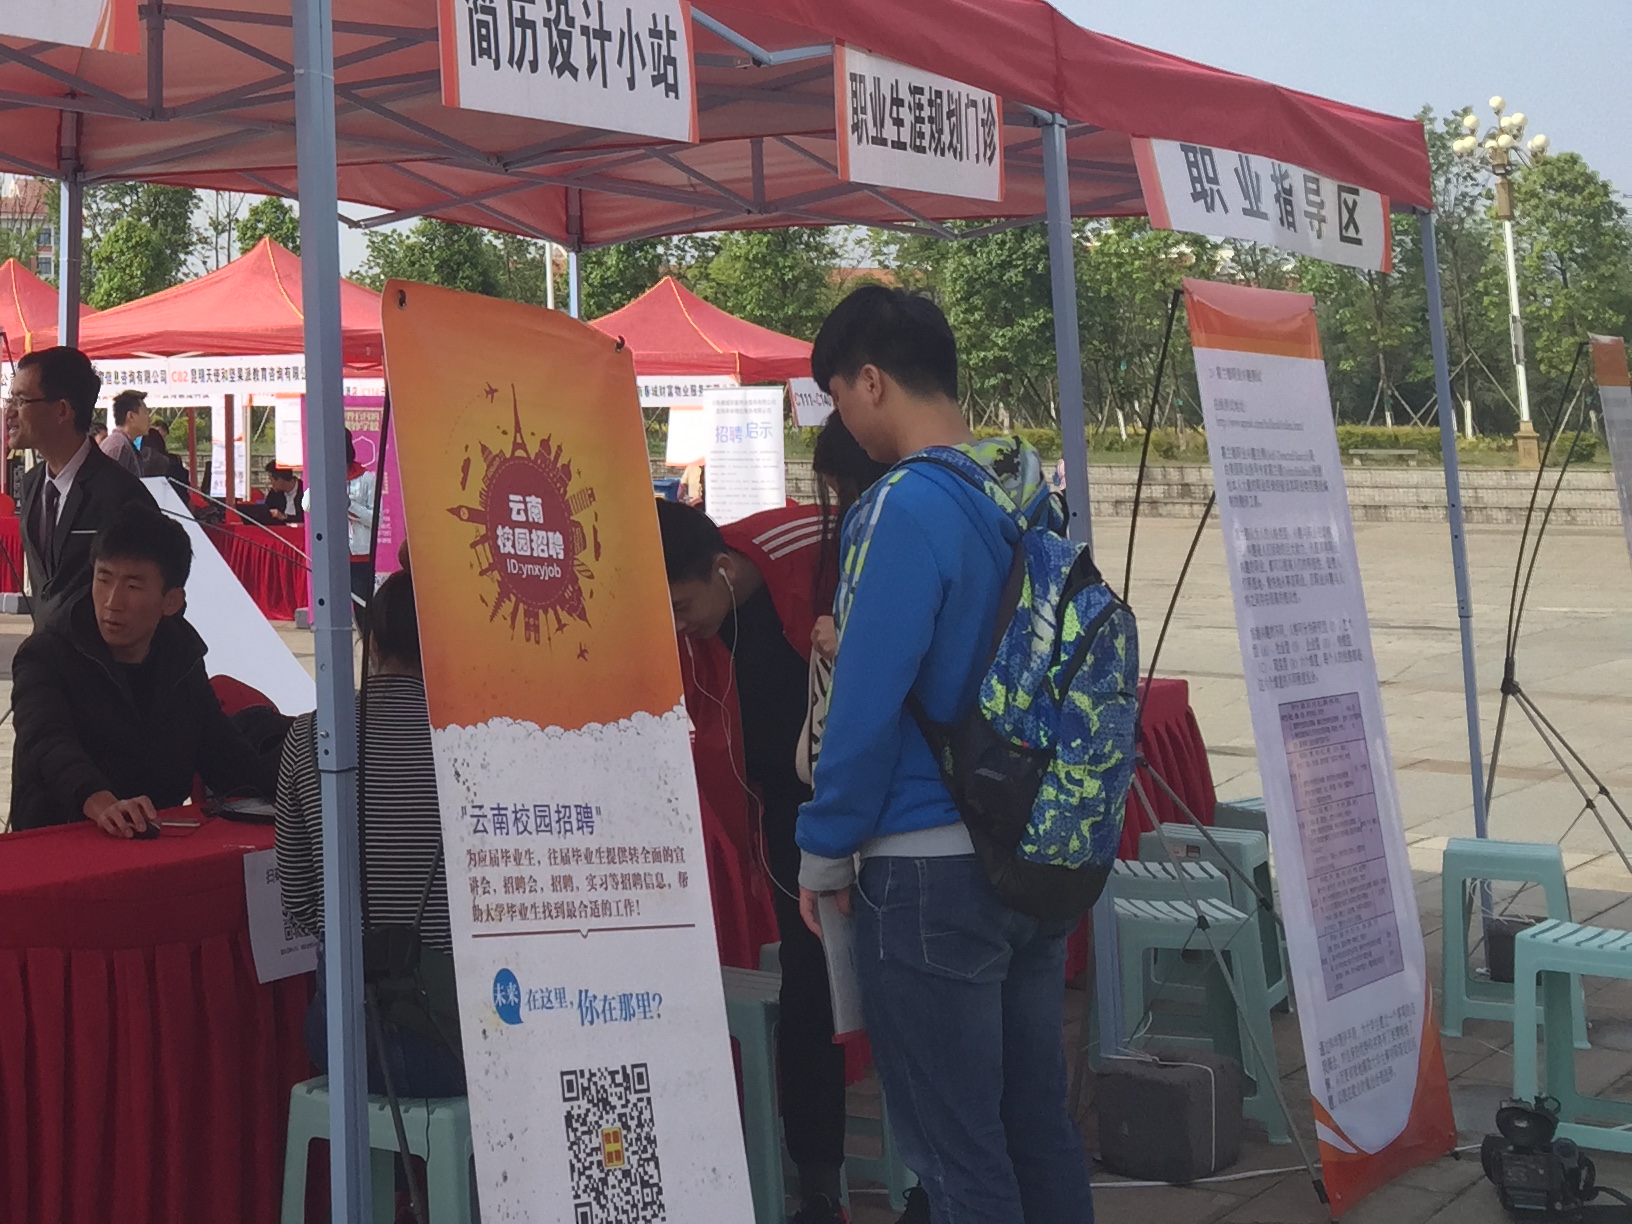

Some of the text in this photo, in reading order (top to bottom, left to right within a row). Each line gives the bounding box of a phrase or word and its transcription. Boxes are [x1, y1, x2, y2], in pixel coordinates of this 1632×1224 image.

[849, 72, 997, 167] 职业生涯规划门诊
[1180, 143, 1363, 246] 职业指导区
[508, 494, 544, 524] 云南
[496, 525, 565, 559] 校园招聘
[506, 558, 562, 580] ID:ynxyjob
[493, 981, 519, 1007] 未来
